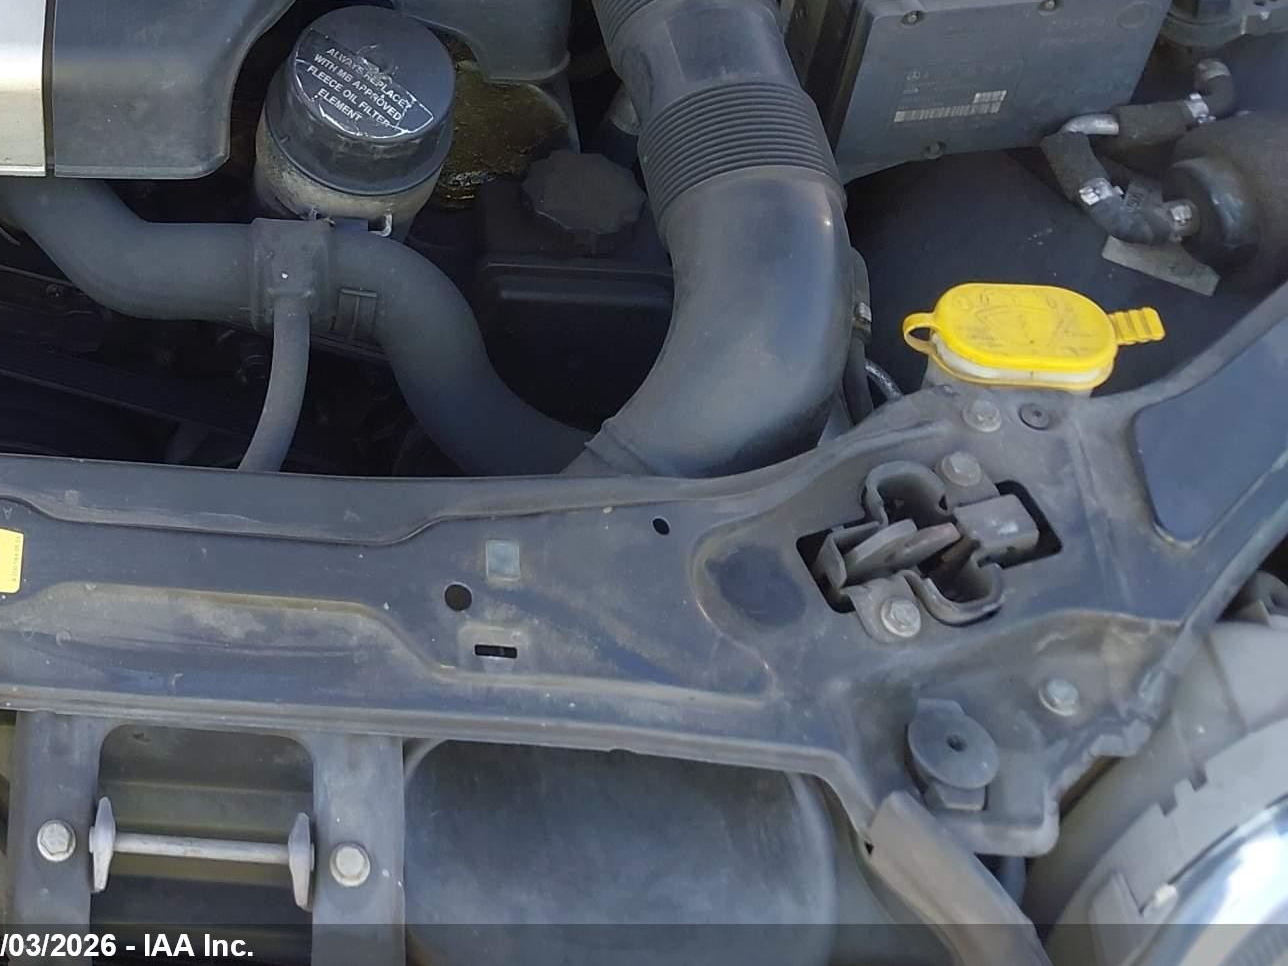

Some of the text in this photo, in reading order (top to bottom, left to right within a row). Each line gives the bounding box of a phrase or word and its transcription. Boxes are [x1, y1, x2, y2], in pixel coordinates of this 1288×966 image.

[307, 64, 391, 127] FLEECE OIL FILTER
[314, 53, 402, 121] WITH MB APPROVED
[318, 87, 363, 121] ELEMENT
